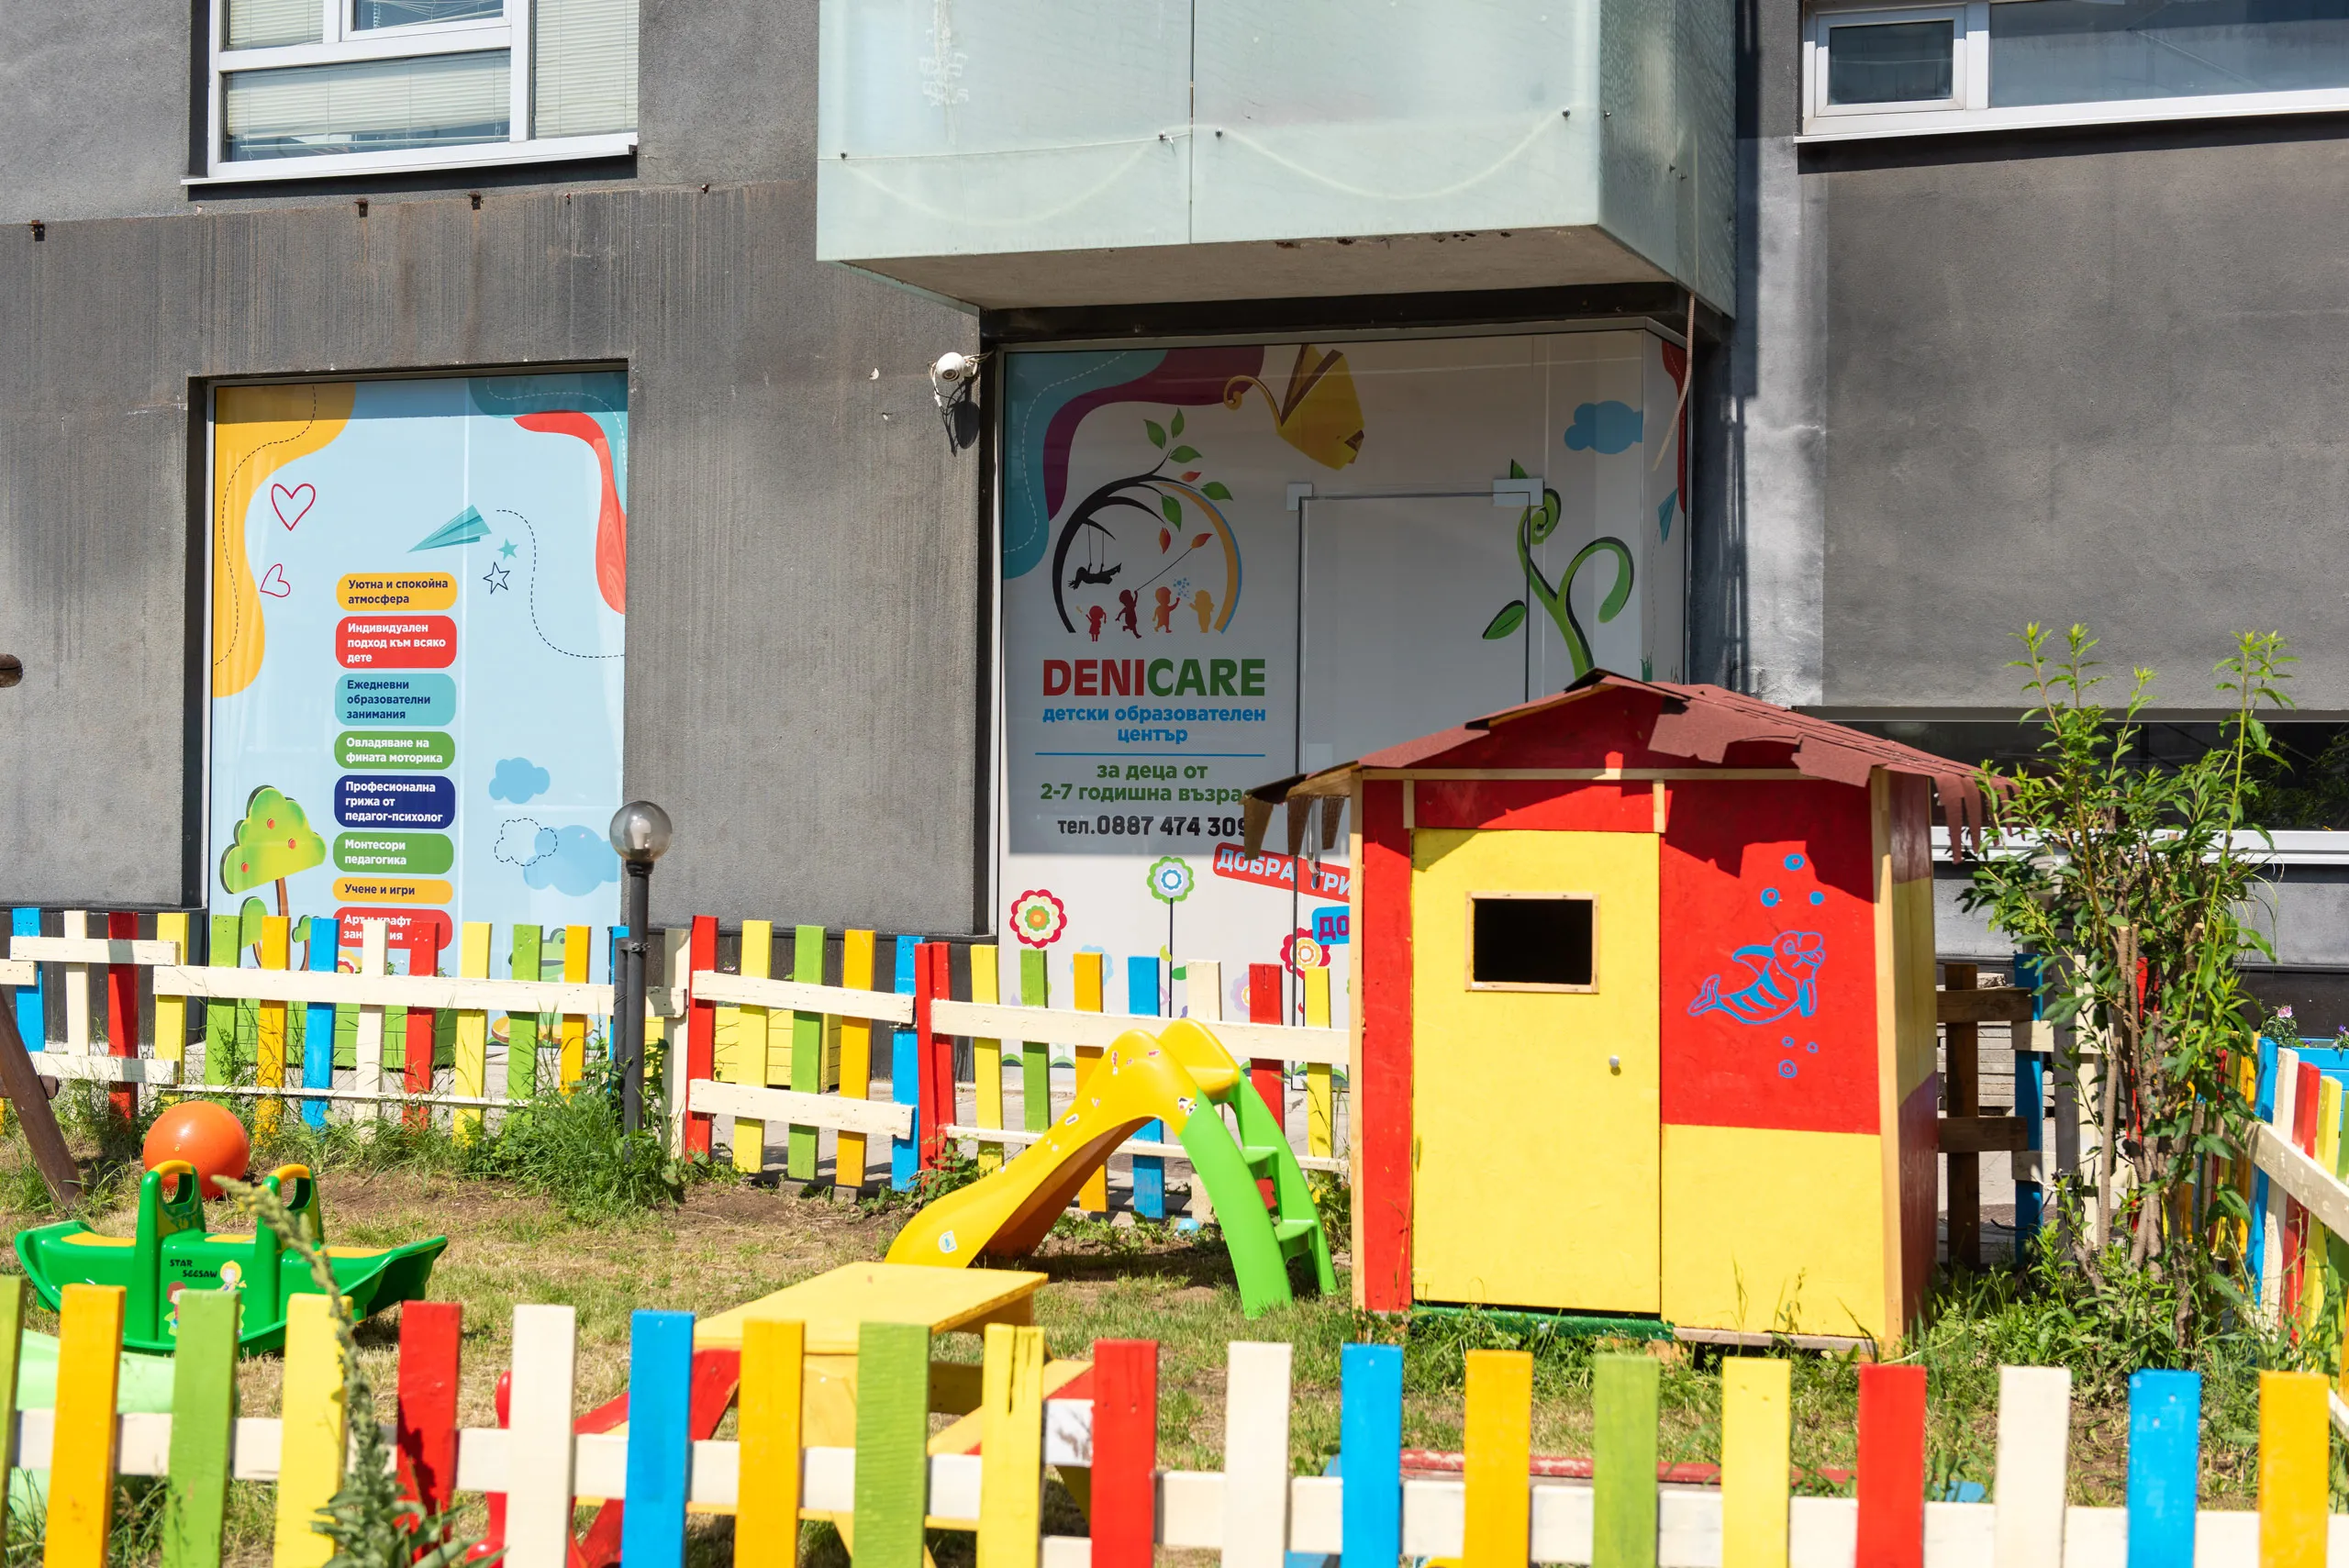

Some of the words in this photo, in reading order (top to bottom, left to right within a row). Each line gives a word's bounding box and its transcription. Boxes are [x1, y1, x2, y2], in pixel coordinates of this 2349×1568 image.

[349, 579, 383, 589] Уютна
[395, 579, 449, 589] спокойна
[348, 595, 409, 605] атмосфера
[348, 623, 429, 634] Индивидуален
[347, 639, 387, 649] подход
[389, 639, 411, 647] към
[413, 639, 446, 647] всяко
[347, 654, 373, 663] дете
[1043, 658, 1265, 696] DENICARE
[347, 680, 409, 690] Ежедневни
[347, 694, 430, 706] образователни
[347, 710, 406, 719] занимания
[1042, 707, 1108, 722] детски
[1114, 706, 1266, 723] образователен
[1118, 728, 1188, 744] център
[346, 738, 413, 749] Овладяване
[416, 740, 429, 748] на
[346, 751, 386, 764] фината
[389, 754, 442, 764] моторика
[1097, 765, 1119, 778] за
[1126, 765, 1177, 780] деца
[1184, 765, 1208, 778] от
[345, 781, 436, 794] Професионална
[1040, 784, 1073, 800] 2-7
[1079, 786, 1172, 802] годишна
[1178, 786, 1244, 805] възра
[345, 796, 380, 807] грижа
[383, 797, 395, 806] от
[345, 811, 443, 823] педагог-психолог
[1160, 817, 1201, 836] 474
[345, 840, 406, 851] Монтесори
[344, 854, 406, 865] педагогика
[344, 884, 377, 894] Учене
[380, 885, 386, 894] и
[389, 886, 416, 896] игри
[1319, 915, 1350, 941] ДО
[344, 930, 403, 940] зания
[170, 1259, 193, 1267] STAR
[183, 1270, 217, 1278] SEESAW
